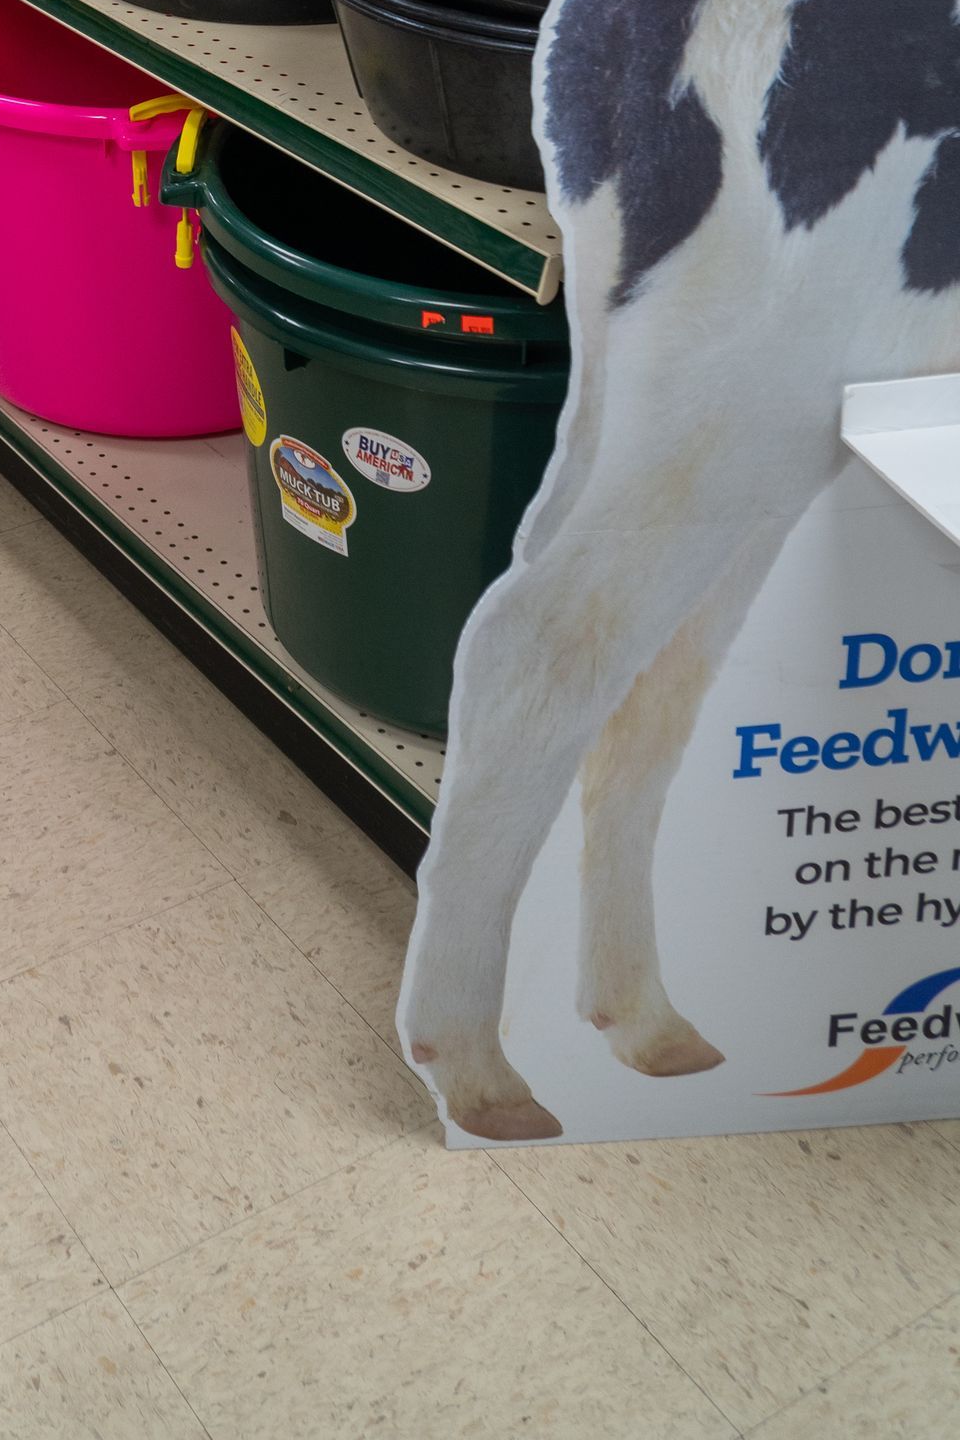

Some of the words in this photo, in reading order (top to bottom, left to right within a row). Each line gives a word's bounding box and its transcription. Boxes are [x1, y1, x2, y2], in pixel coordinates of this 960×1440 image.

[356, 447, 414, 481] AMERICAN
[359, 435, 390, 460] BUY
[280, 466, 313, 499] MUCK
[313, 488, 340, 512] TUB
[777, 805, 861, 838] The
[795, 859, 851, 885] on
[864, 847, 939, 879] the
[765, 906, 819, 942] by
[829, 898, 903, 930] the
[896, 1043, 959, 1074] perfo
